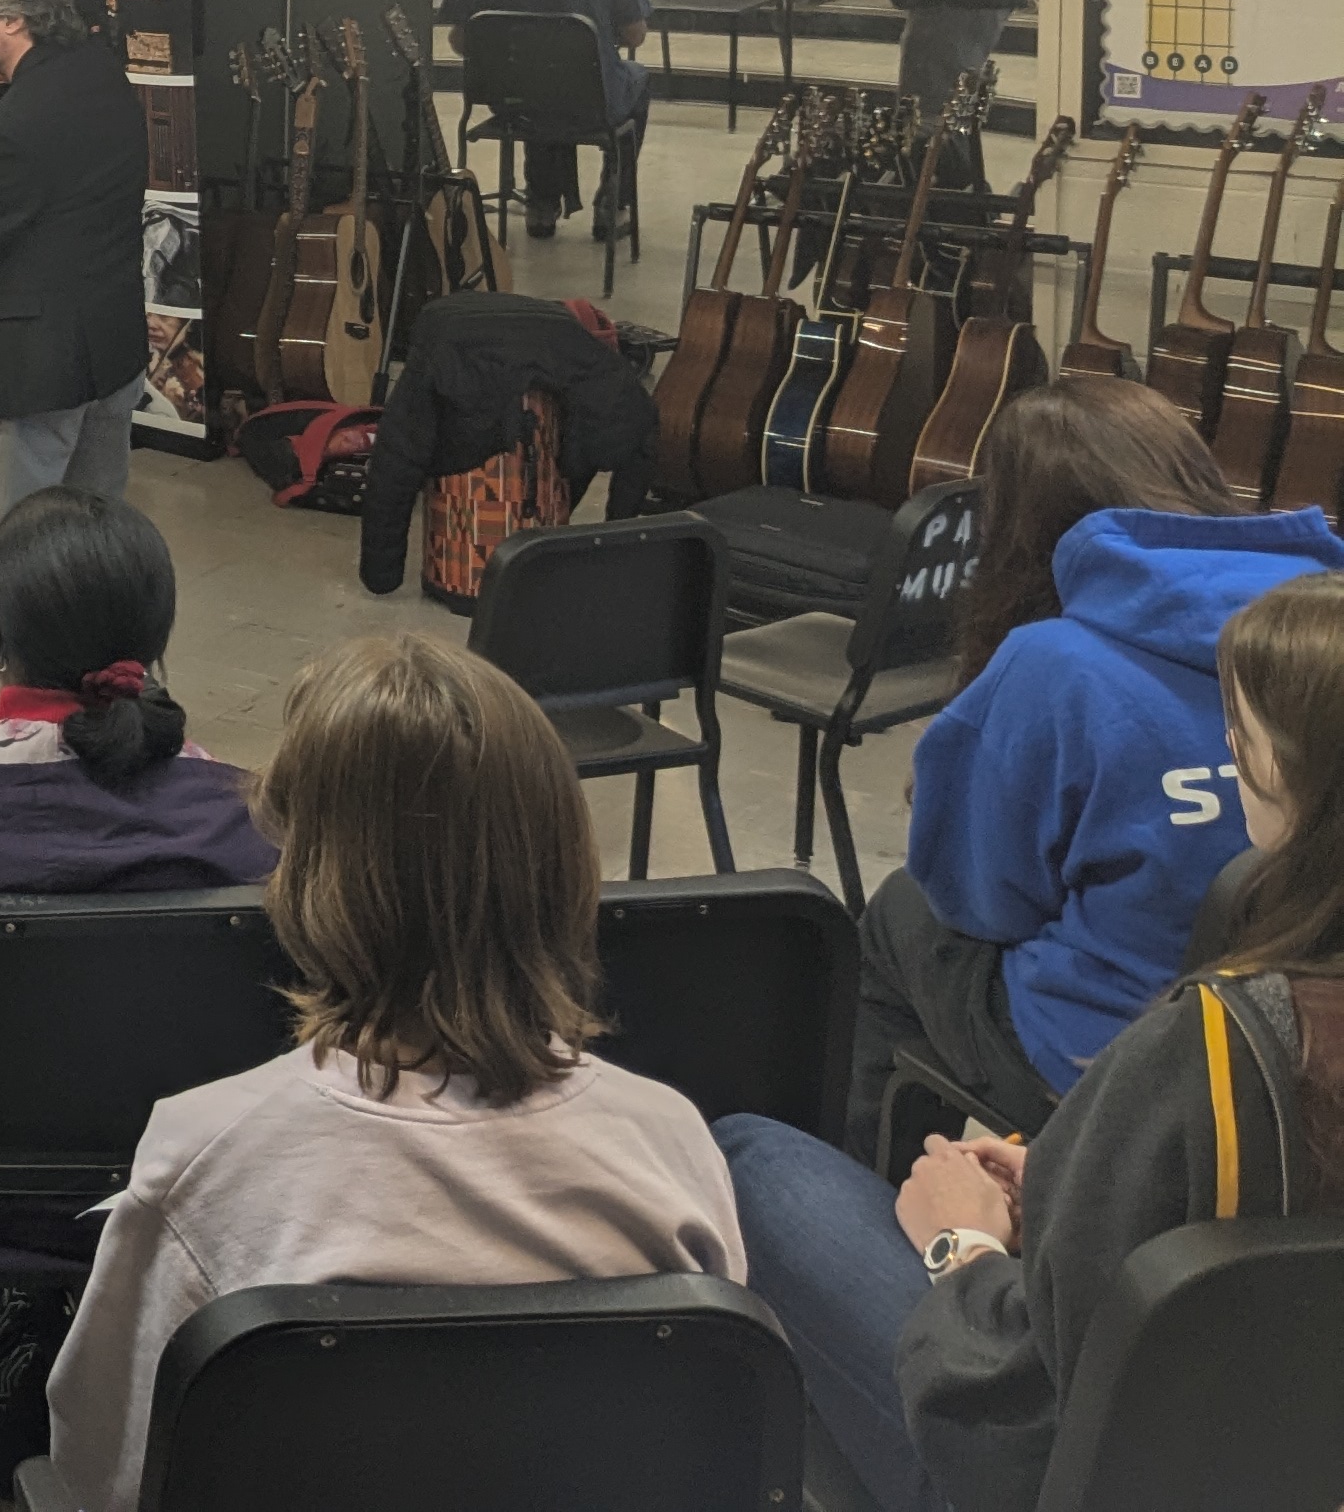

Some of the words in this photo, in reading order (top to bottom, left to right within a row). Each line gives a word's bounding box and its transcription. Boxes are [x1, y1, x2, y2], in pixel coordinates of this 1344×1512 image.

[923, 512, 972, 548] PA
[900, 556, 980, 601] MUS
[1162, 764, 1238, 824] S
